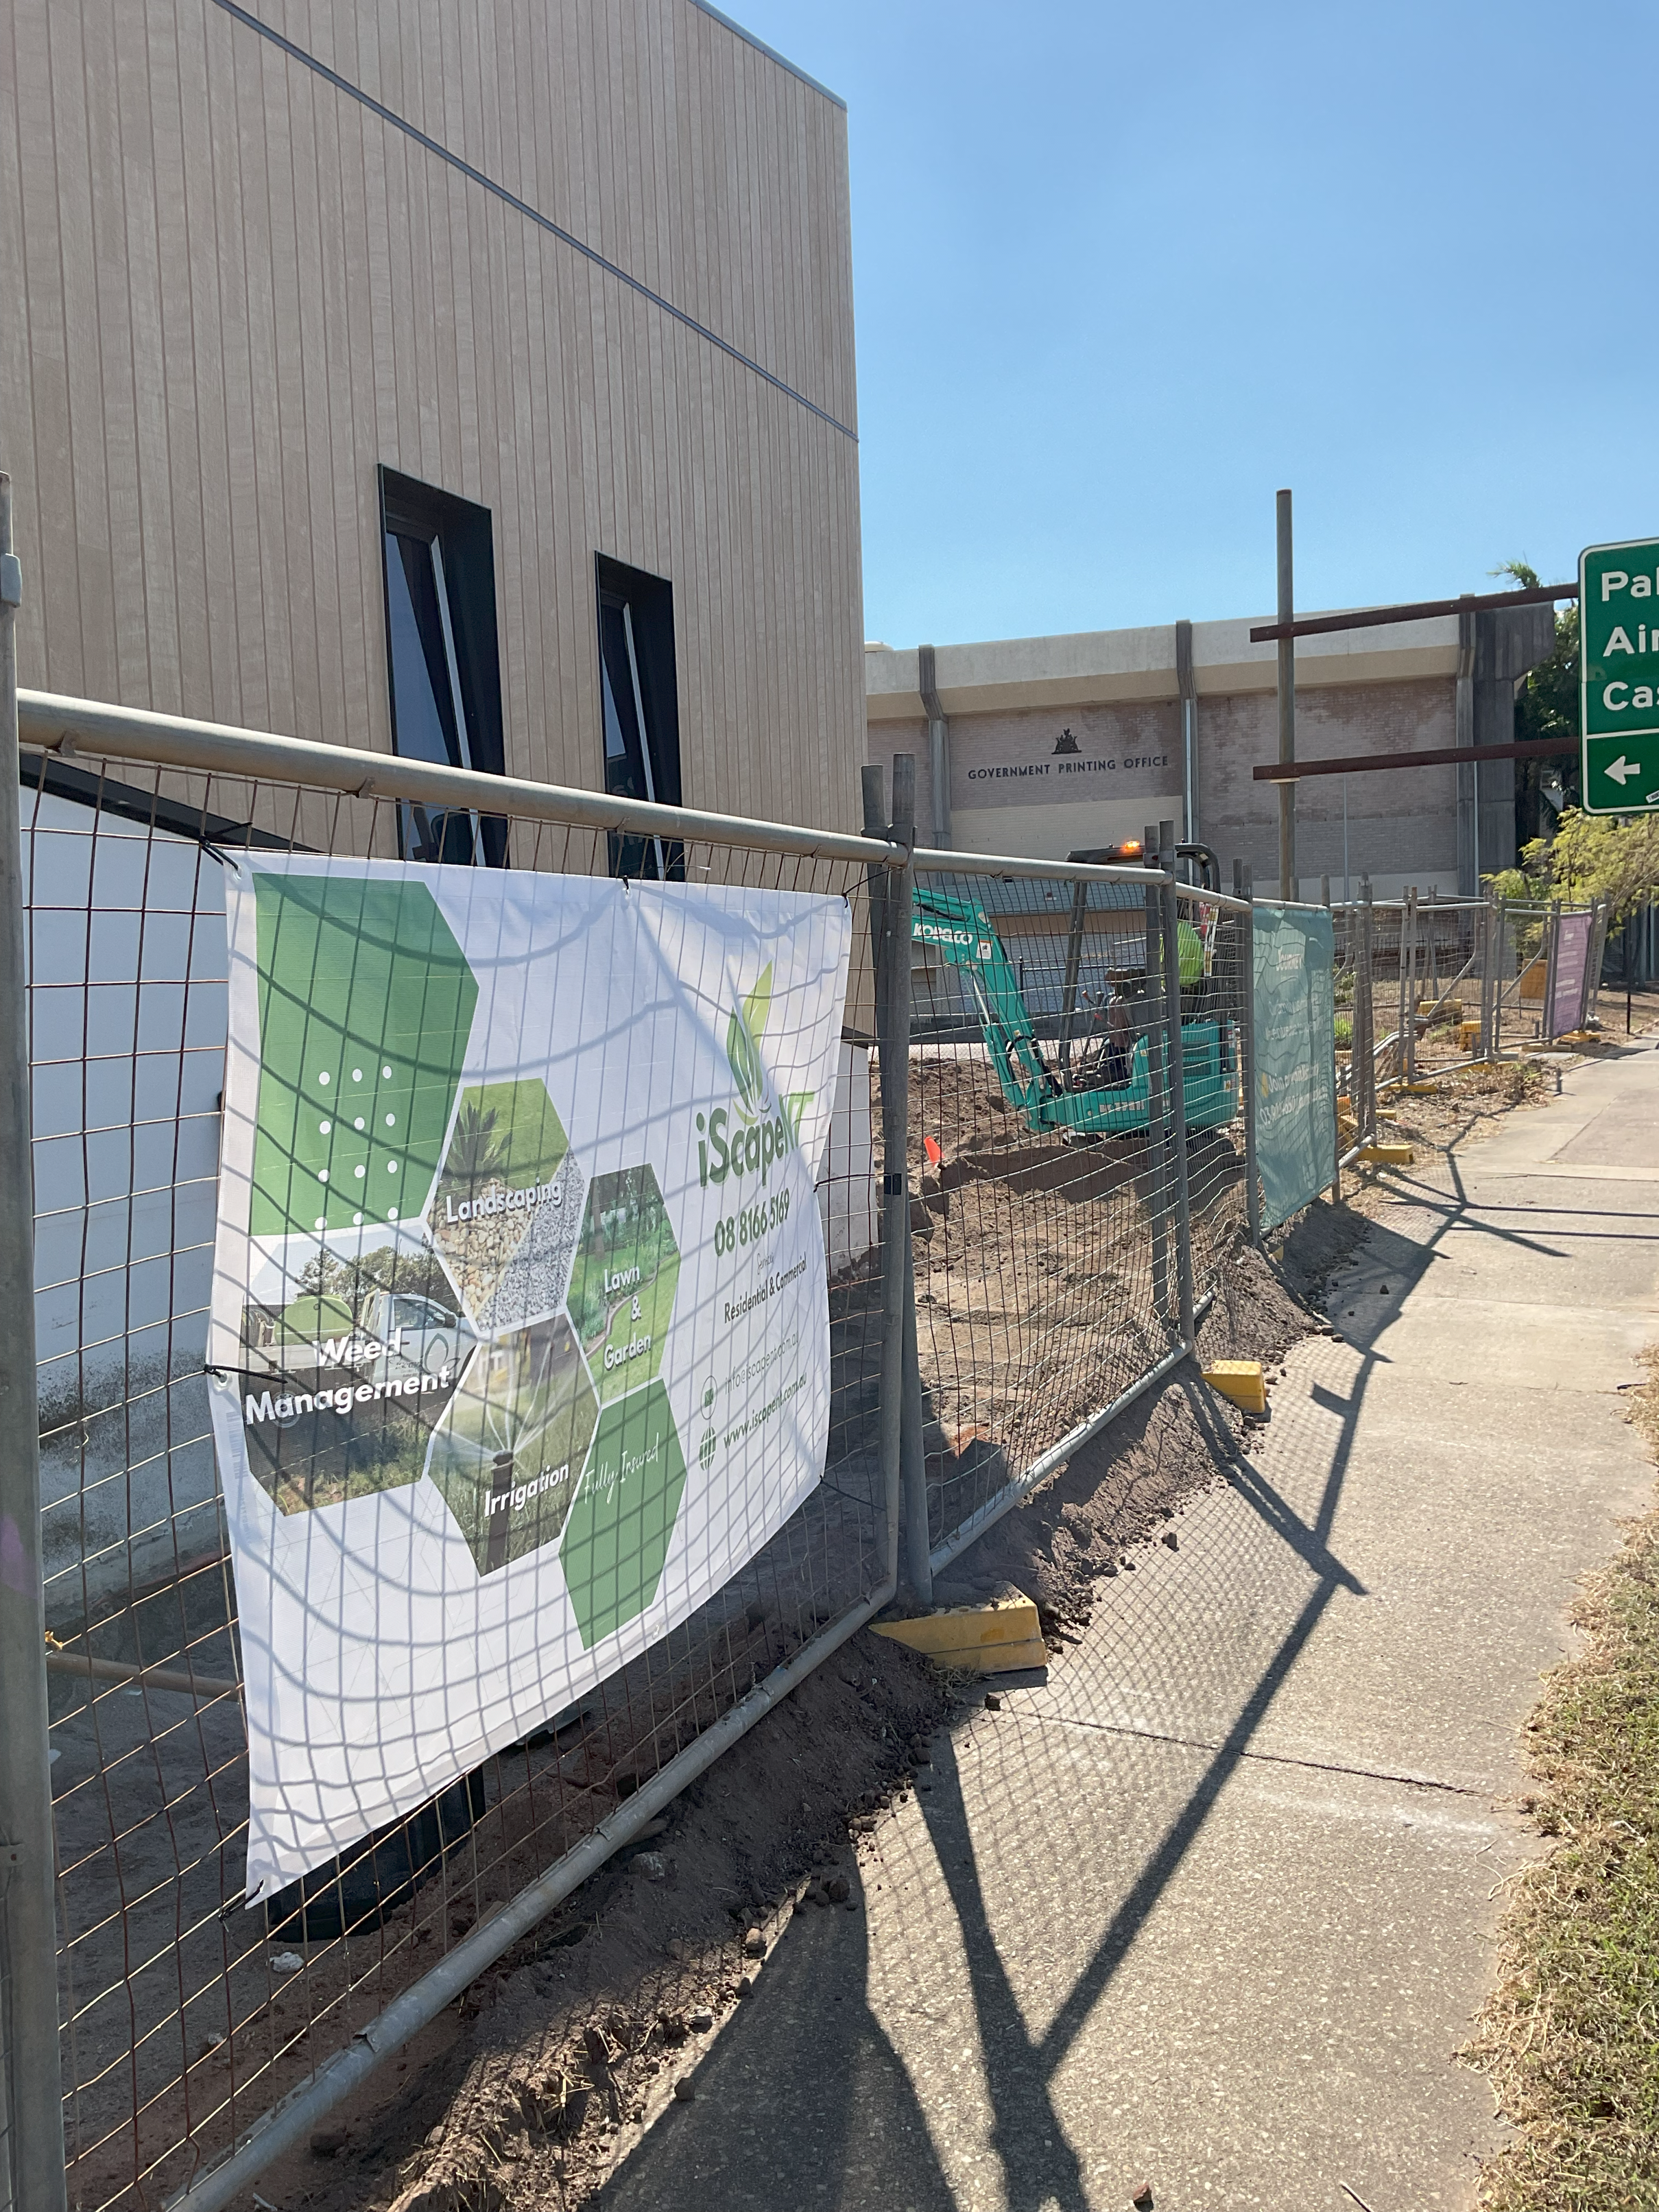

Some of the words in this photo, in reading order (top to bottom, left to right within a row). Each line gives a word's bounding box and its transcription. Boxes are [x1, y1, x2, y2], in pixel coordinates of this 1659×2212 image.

[1603, 681, 1659, 711] Ca
[968, 763, 1051, 780] GOVERNMENT
[1058, 759, 1117, 774] PRINTING
[1123, 755, 1169, 769] OFFICE
[913, 923, 973, 945] KOBELCO
[446, 1176, 563, 1226] Landscaping
[715, 1220, 735, 1257] 08
[739, 1200, 767, 1246] 8166
[769, 1187, 789, 1230] 5169
[604, 1265, 641, 1294] Lawn
[724, 1279, 768, 1324] Residential
[769, 1276, 776, 1296] &
[776, 1250, 807, 1292] Commercial
[631, 1294, 642, 1322] &
[312, 1327, 402, 1367] Weed
[604, 1331, 652, 1371] Garden
[246, 1365, 450, 1425] Management
[723, 1372, 807, 1449] www.iscapent.com.au
[484, 1463, 569, 1518] Irrigation
[584, 1461, 618, 1505] Fully
[619, 1431, 659, 1484] Insured
